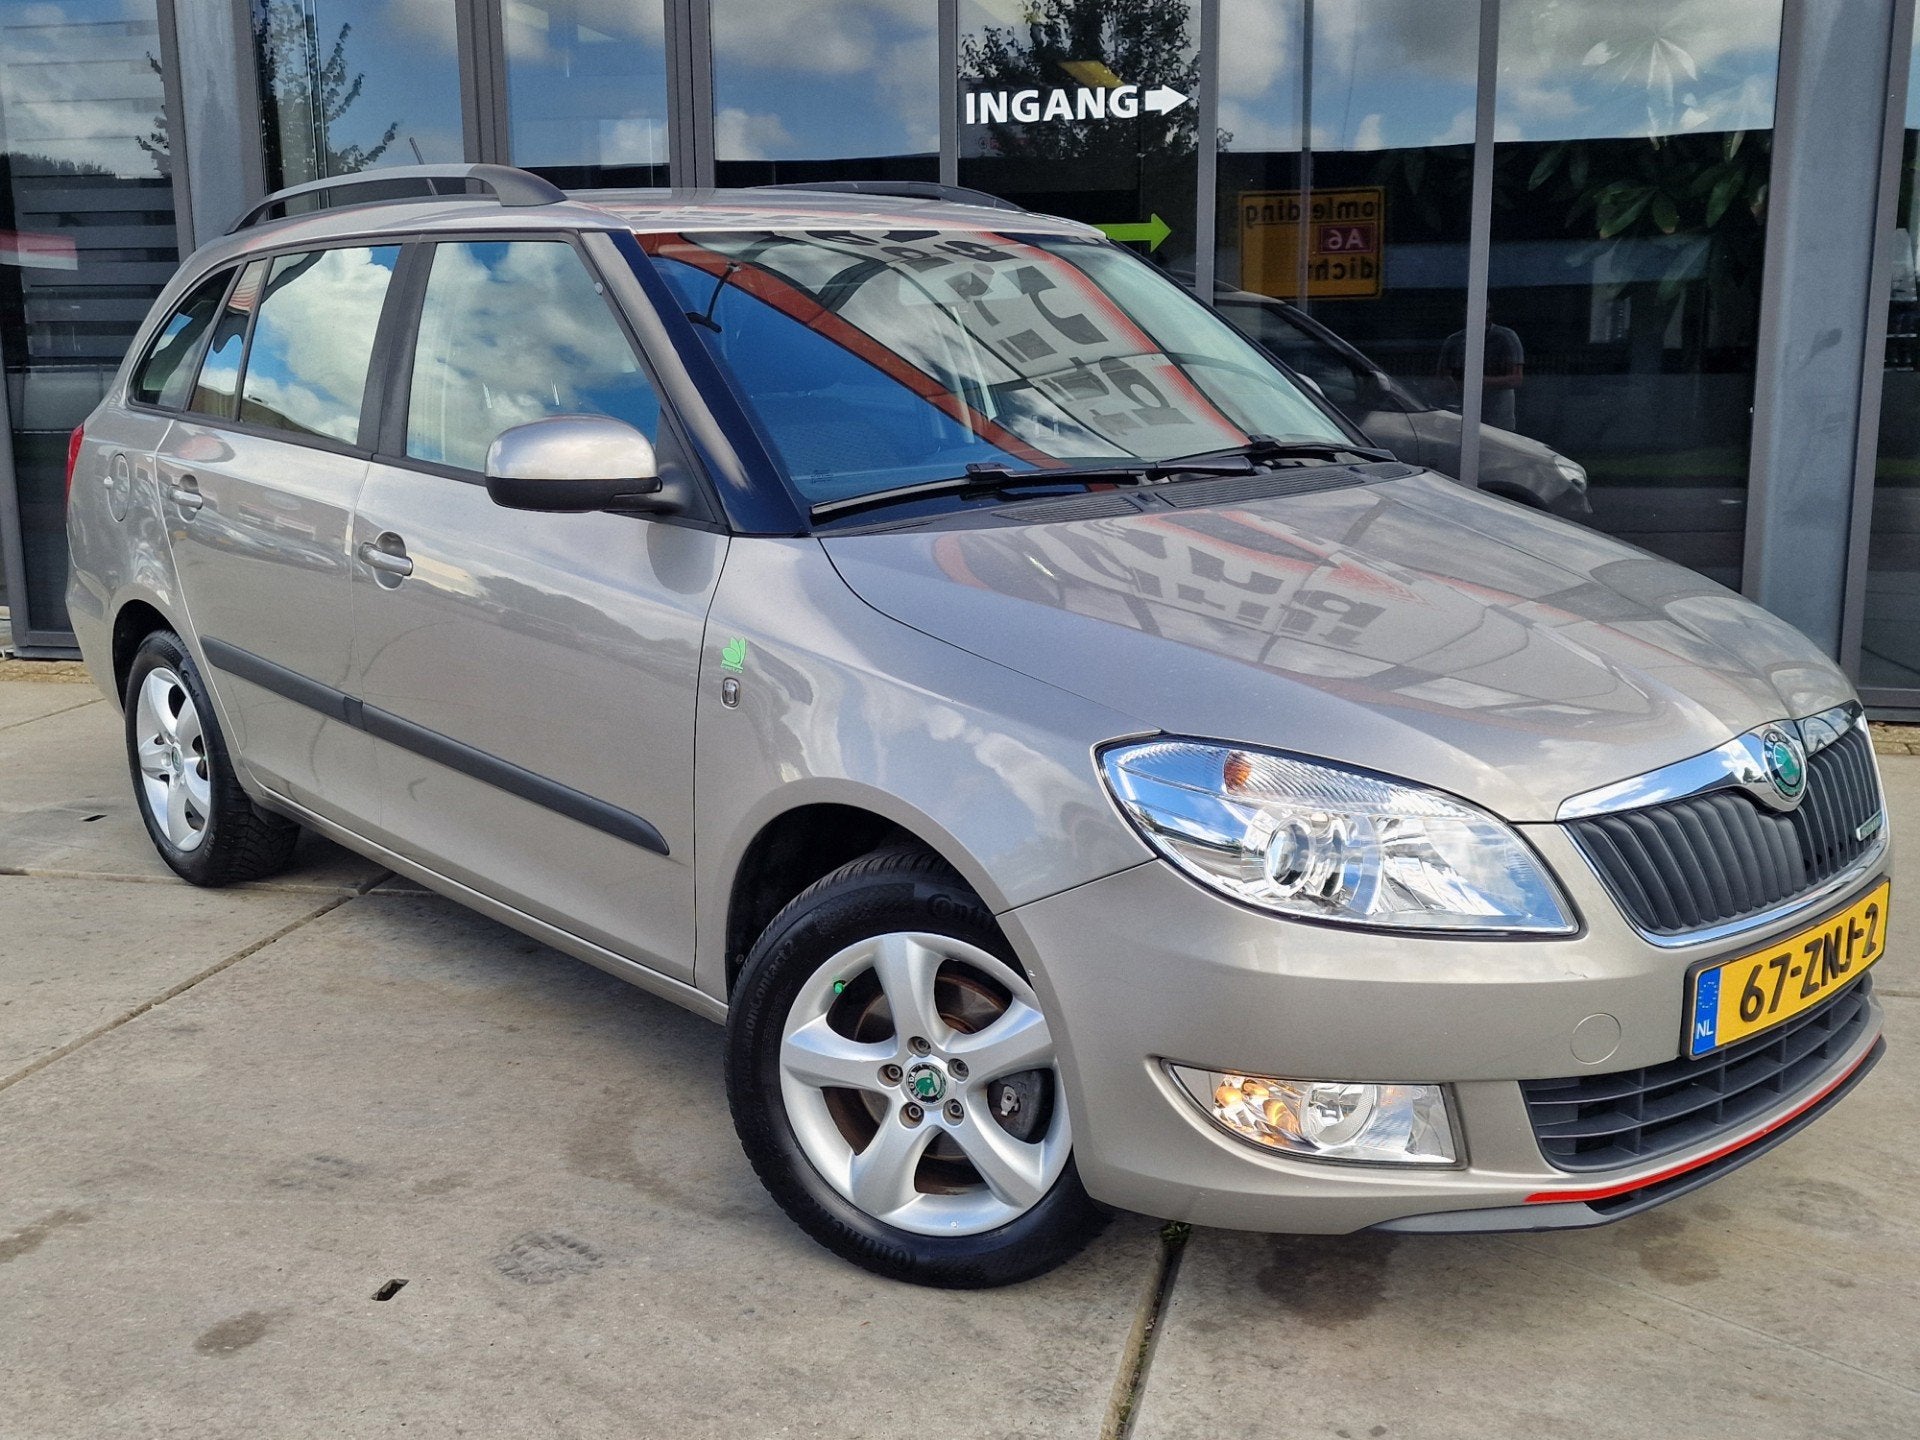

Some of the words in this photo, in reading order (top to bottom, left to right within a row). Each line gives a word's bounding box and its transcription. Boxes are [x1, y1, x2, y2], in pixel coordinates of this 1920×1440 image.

[965, 85, 1139, 124] INGANG
[1739, 902, 1879, 1023] 67-ZNJ-2
[1695, 1019, 1714, 1040] NL
